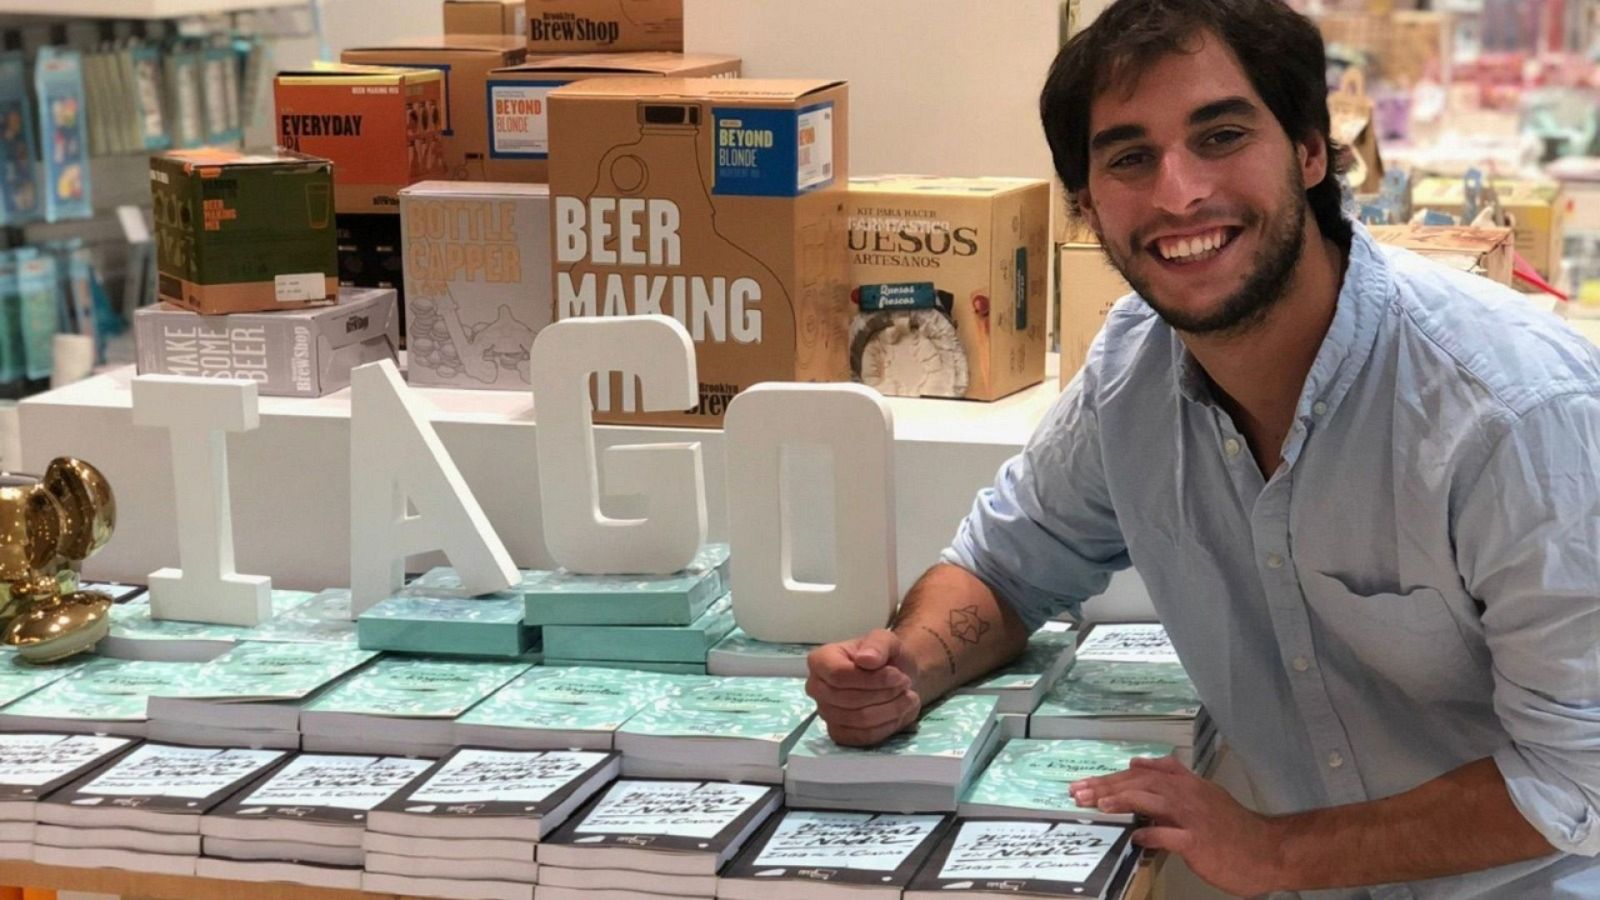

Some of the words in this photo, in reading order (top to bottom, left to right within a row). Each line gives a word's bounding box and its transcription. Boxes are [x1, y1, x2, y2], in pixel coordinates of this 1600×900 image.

[530, 18, 619, 44] BrewShop
[495, 99, 541, 115] BEYOND
[281, 114, 363, 136] EVERYDAY
[495, 116, 529, 133] BLONDE
[719, 129, 773, 148] BEYOND
[719, 149, 758, 168] BLONDE
[407, 200, 519, 241] BOTTLE
[555, 196, 681, 265] BEER
[408, 241, 522, 284] CAPPER
[853, 254, 941, 268] ARTESANOS
[557, 271, 762, 344] MAKING
[198, 327, 232, 379] SOME
[231, 325, 269, 384] BEER
